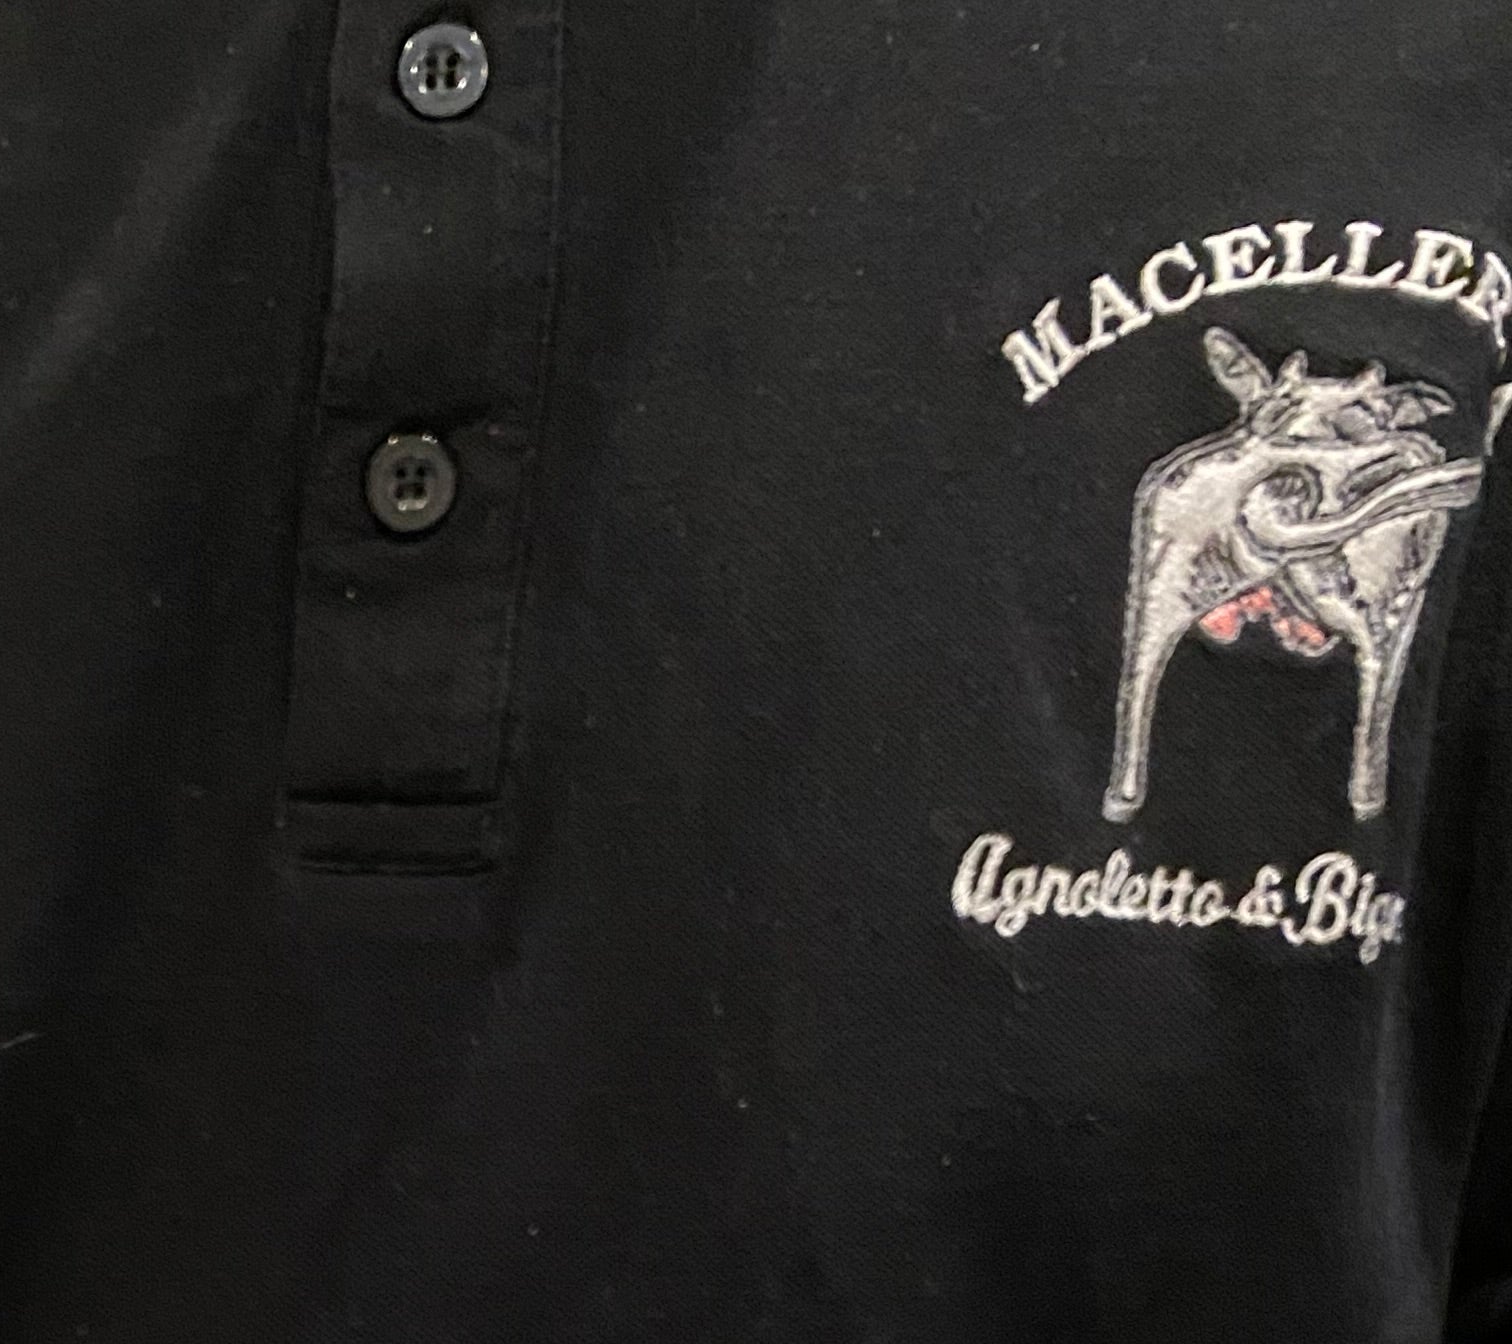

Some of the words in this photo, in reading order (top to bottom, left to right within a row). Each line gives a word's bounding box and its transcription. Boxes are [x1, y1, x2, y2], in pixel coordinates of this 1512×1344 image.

[1001, 219, 1512, 456] MACELLER
[951, 833, 1231, 937] Agnoletto
[1231, 864, 1285, 927] &
[1282, 851, 1406, 965] Big
